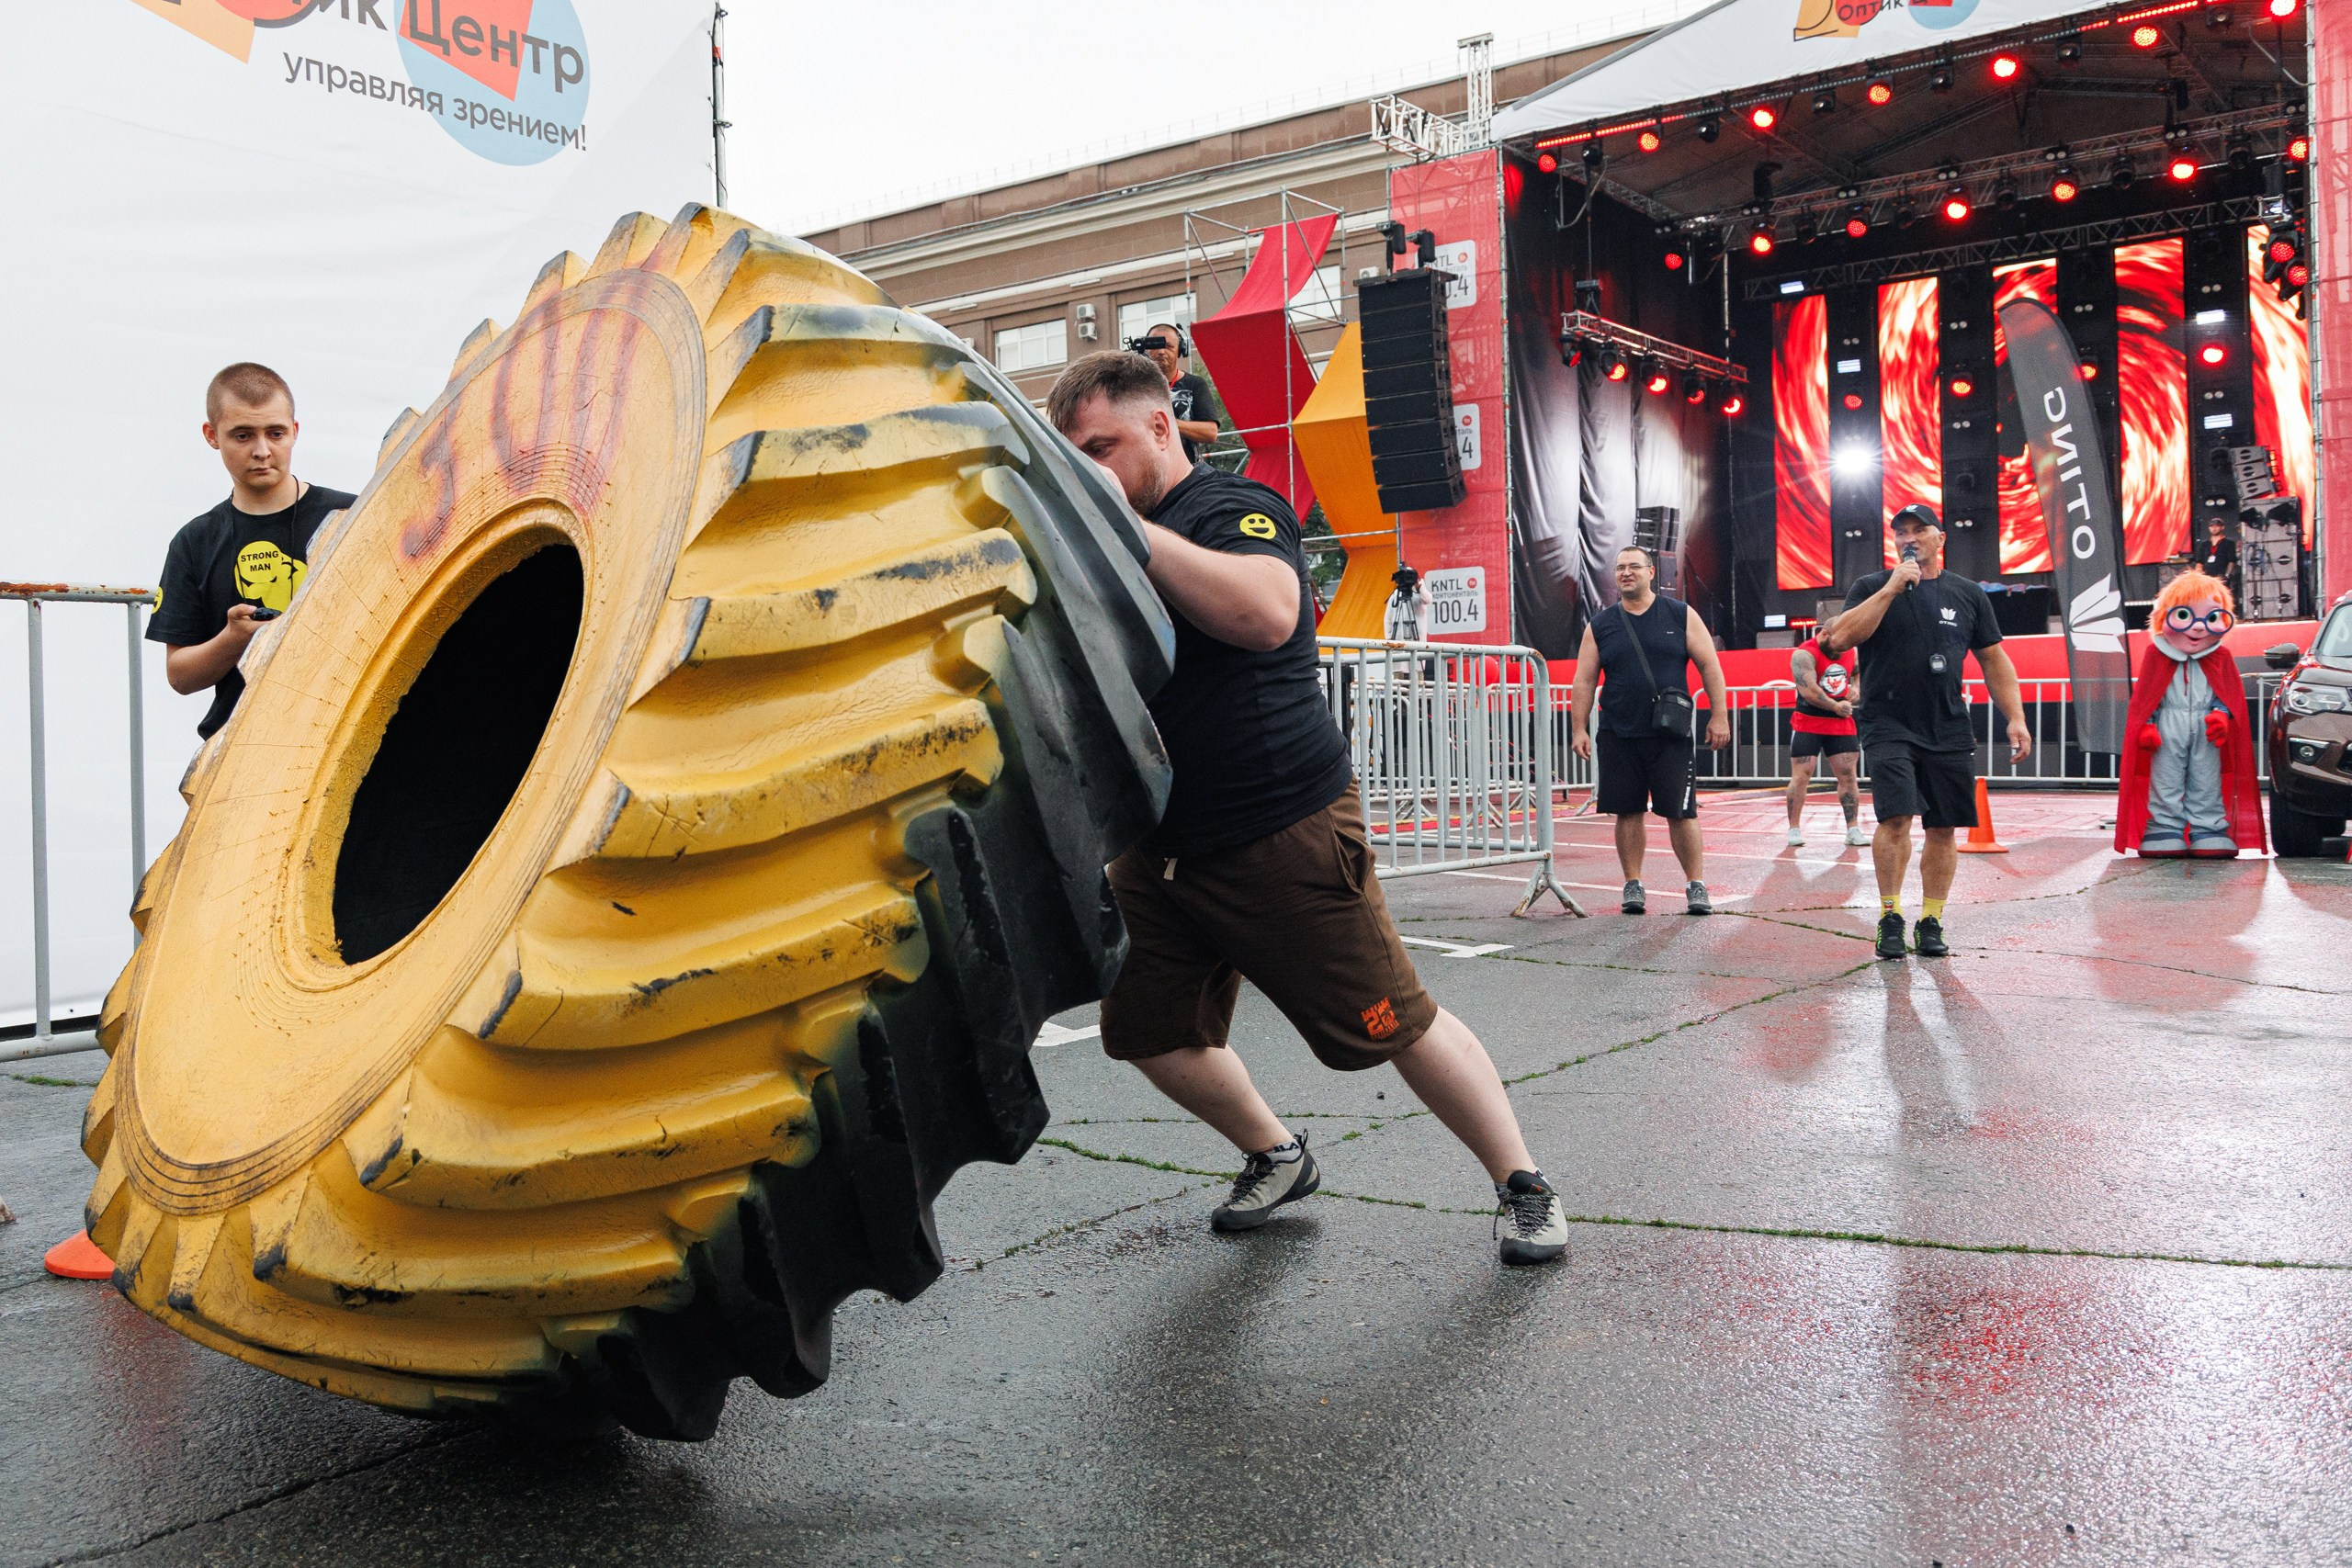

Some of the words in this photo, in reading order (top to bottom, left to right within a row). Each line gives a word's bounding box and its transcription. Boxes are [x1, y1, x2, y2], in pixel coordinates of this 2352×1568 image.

[1838, 0, 1904, 21] Оптик
[408, 0, 584, 93] Центр
[283, 51, 444, 116] управляя
[453, 97, 586, 152] зрением!
[241, 551, 279, 562] STRONG
[250, 563, 271, 572] MAN
[1431, 579, 1463, 592] KNTL
[1432, 599, 1478, 624] 100.4
